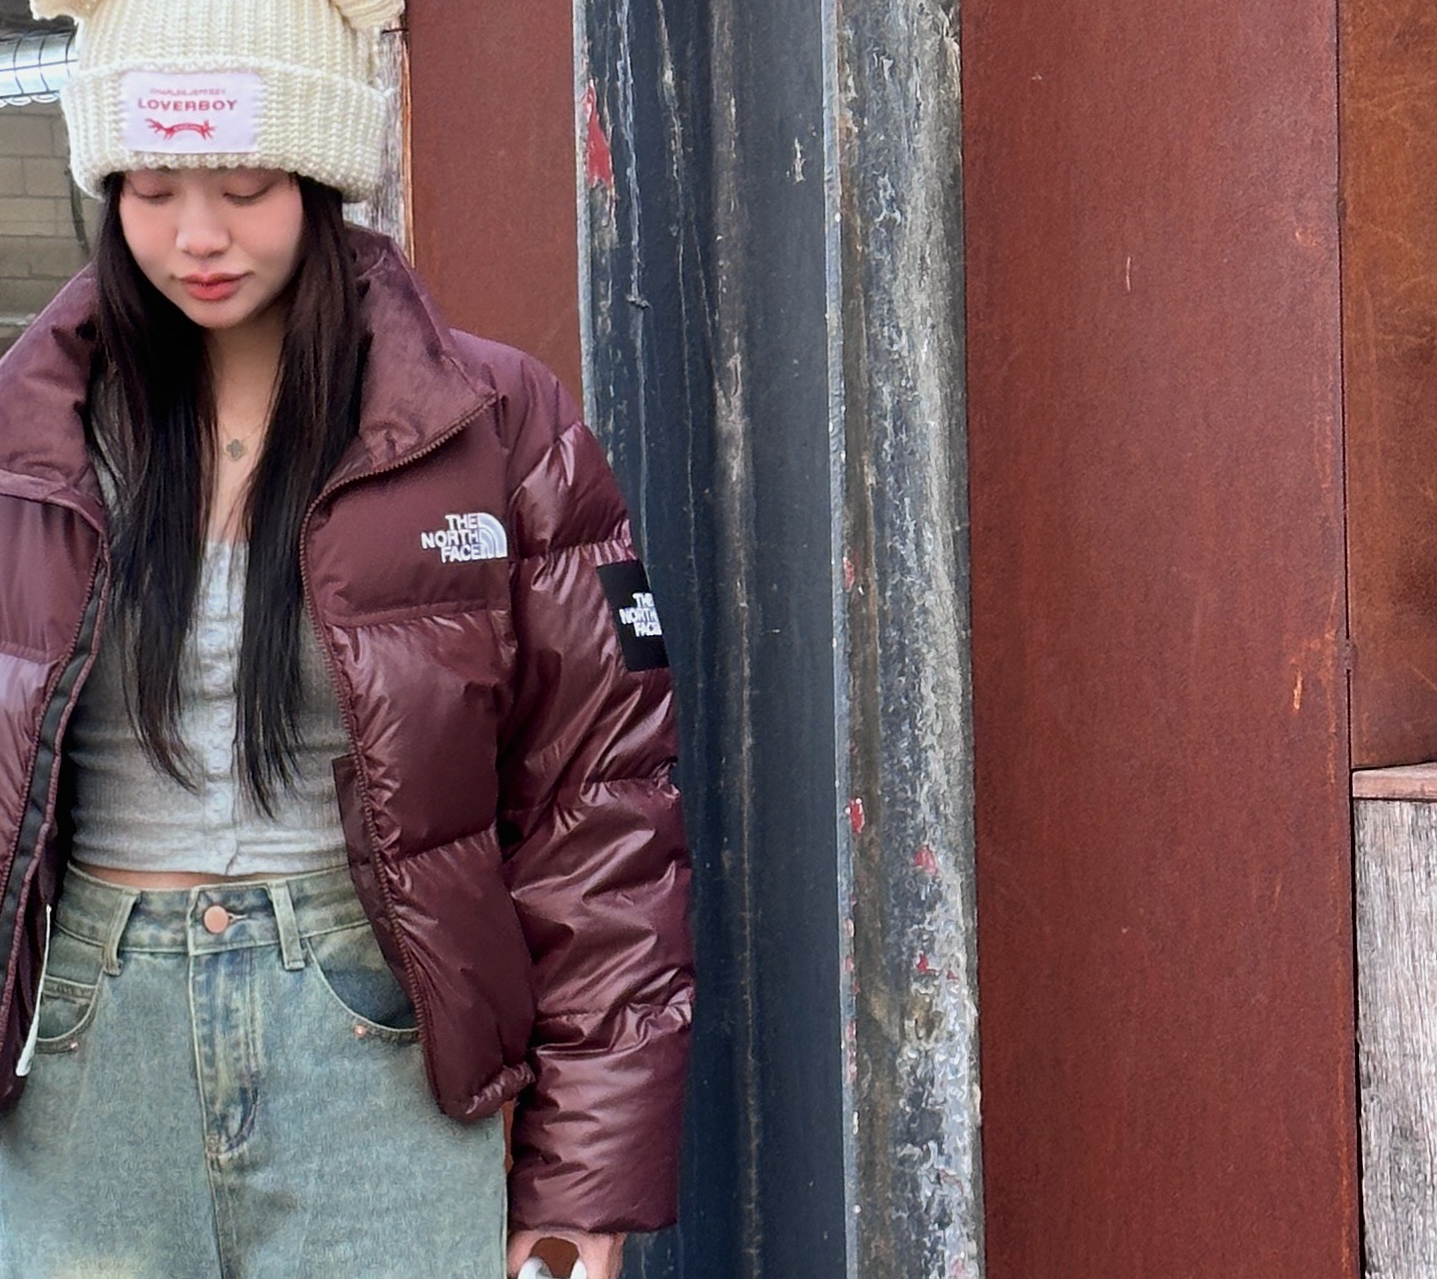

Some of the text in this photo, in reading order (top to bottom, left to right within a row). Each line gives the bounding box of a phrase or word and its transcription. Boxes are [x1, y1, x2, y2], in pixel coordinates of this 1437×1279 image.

[137, 97, 238, 112] LOVERBOY
[444, 512, 479, 531] THE
[420, 529, 479, 550] NORTH
[440, 544, 482, 564] FACE
